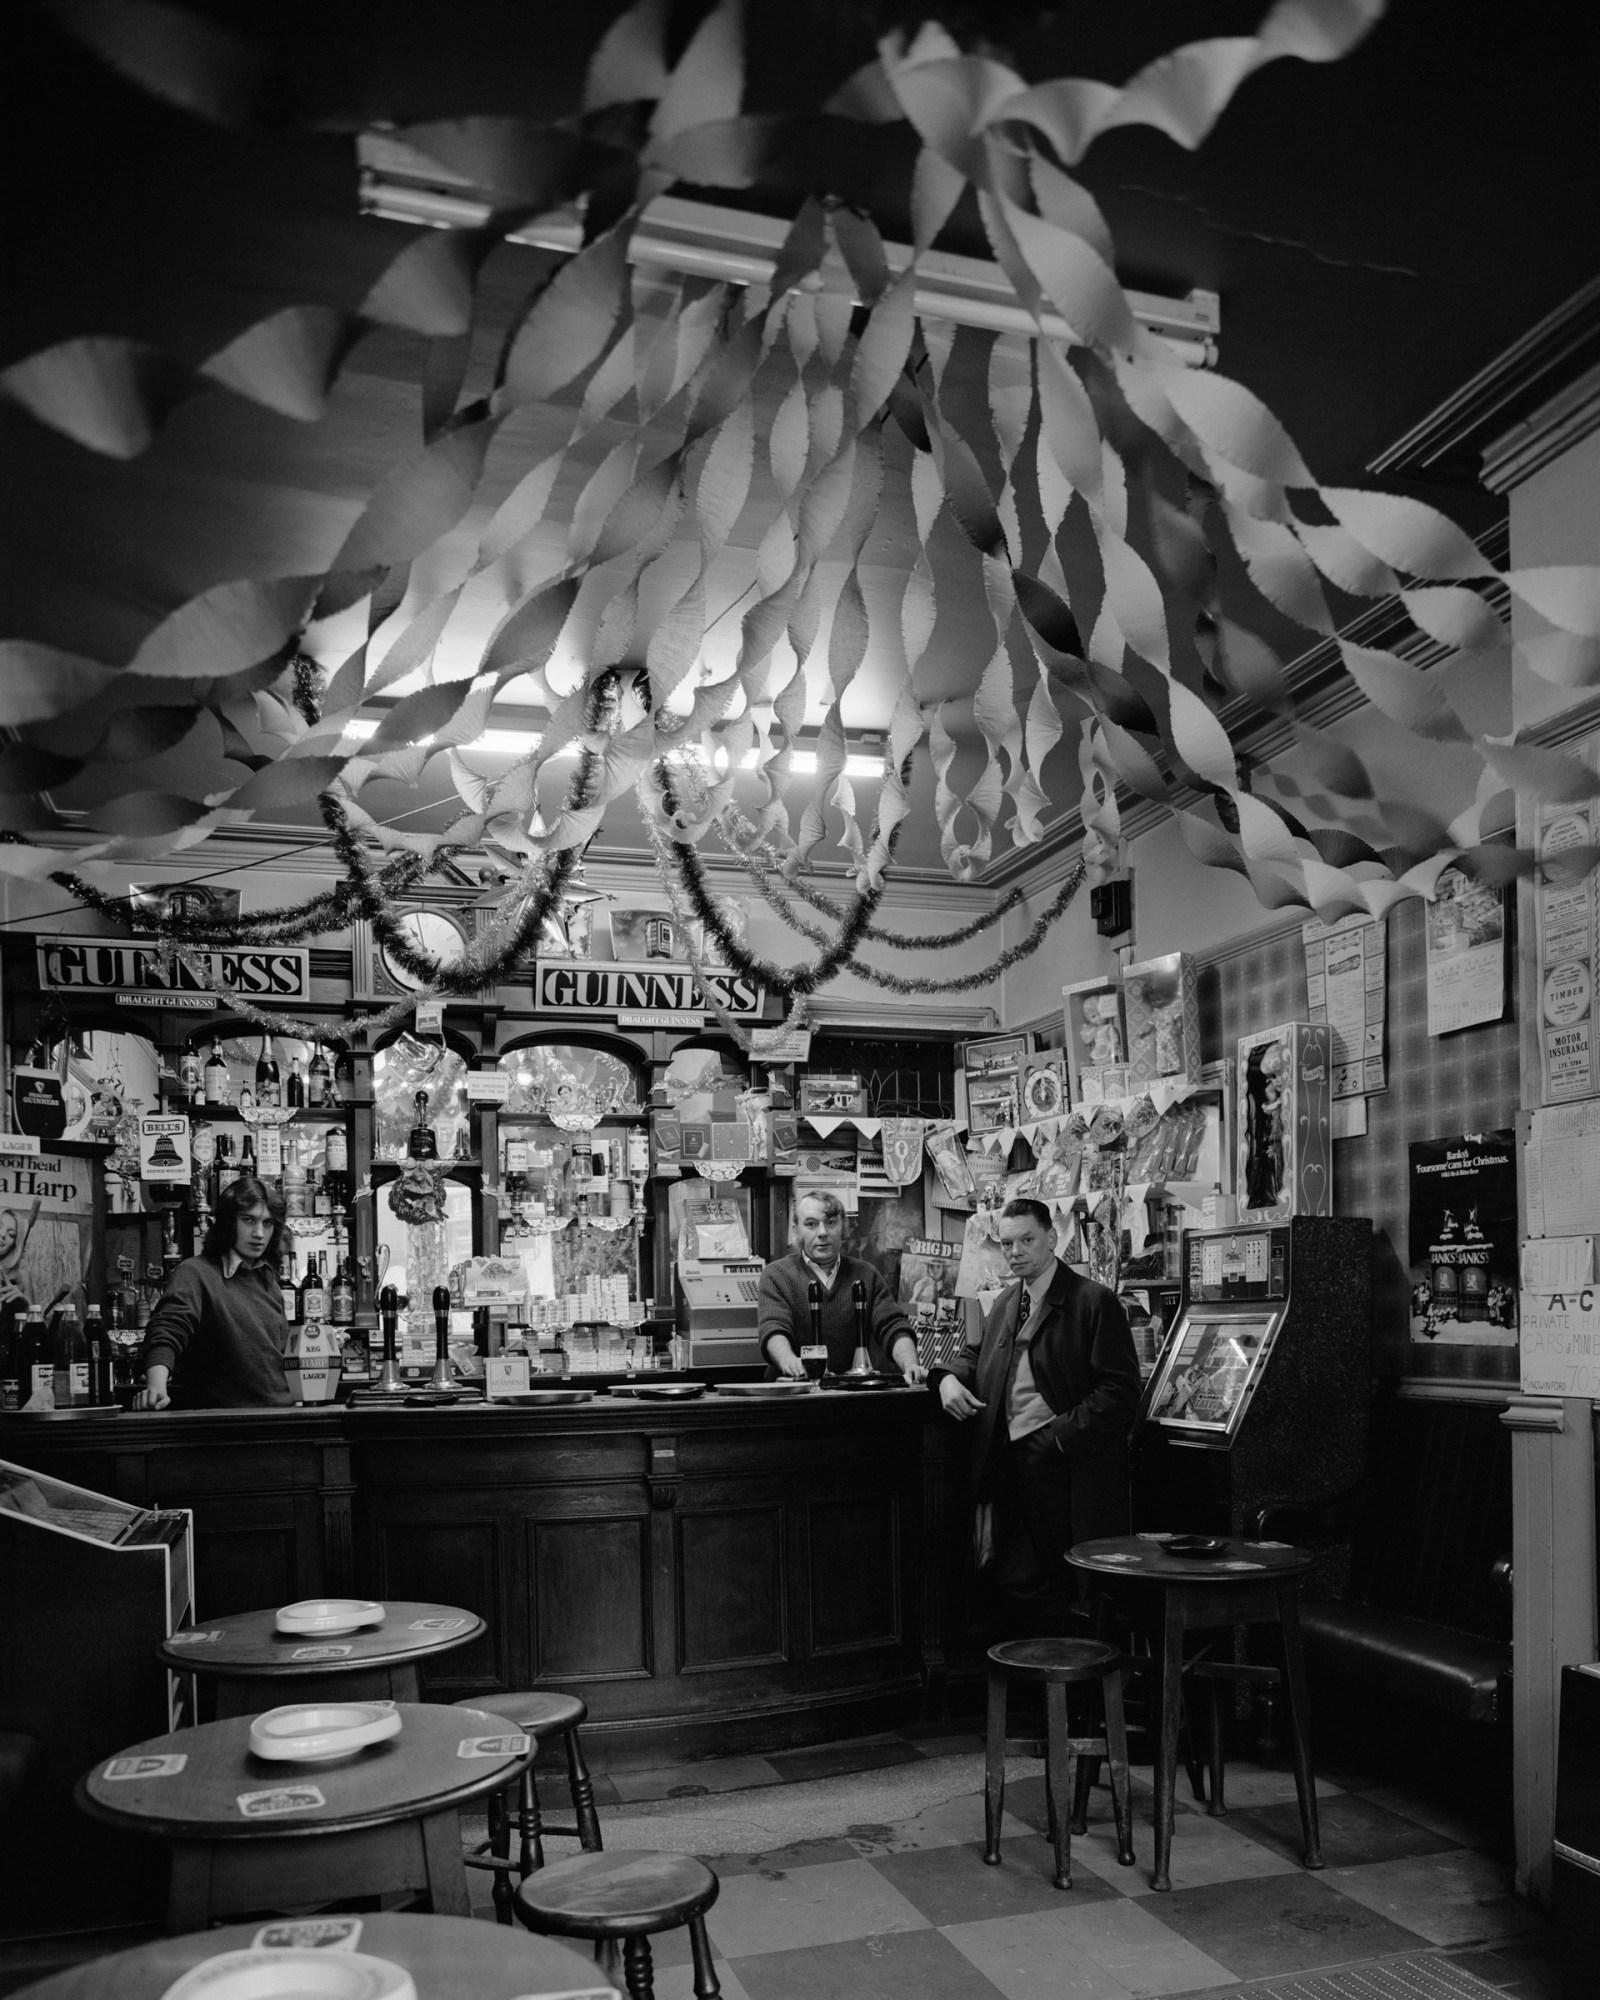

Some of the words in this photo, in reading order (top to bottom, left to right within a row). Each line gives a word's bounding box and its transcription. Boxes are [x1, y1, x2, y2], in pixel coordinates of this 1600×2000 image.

[49, 946, 300, 994] GUINNESS
[544, 970, 757, 1011] GUINNESS
[1550, 986, 1584, 1001] TIMBER
[119, 995, 165, 1005] DRAUGHT
[166, 997, 214, 1007] GUINNESS
[621, 1015, 660, 1024] DRAUGHT
[660, 1017, 701, 1025] GUINNESS
[1555, 1032, 1581, 1047] MOTOR
[1549, 1041, 1590, 1059] INSURANCE
[22, 1096, 60, 1106] GUINNESS
[147, 1123, 181, 1132] BELL'S
[2, 1141, 33, 1151] LAGER
[0, 1156, 24, 1169] ool
[28, 1156, 61, 1172] head
[1448, 1160, 1462, 1170] cans
[1463, 1158, 1472, 1168] for
[1473, 1155, 1509, 1167] Christmas.
[13, 1170, 77, 1202] Harp
[917, 1240, 940, 1256] BIG
[941, 1243, 952, 1257] D
[1523, 1315, 1570, 1329] PRIVATE
[1523, 1333, 1564, 1354] CARS
[301, 1358, 328, 1368] HARP
